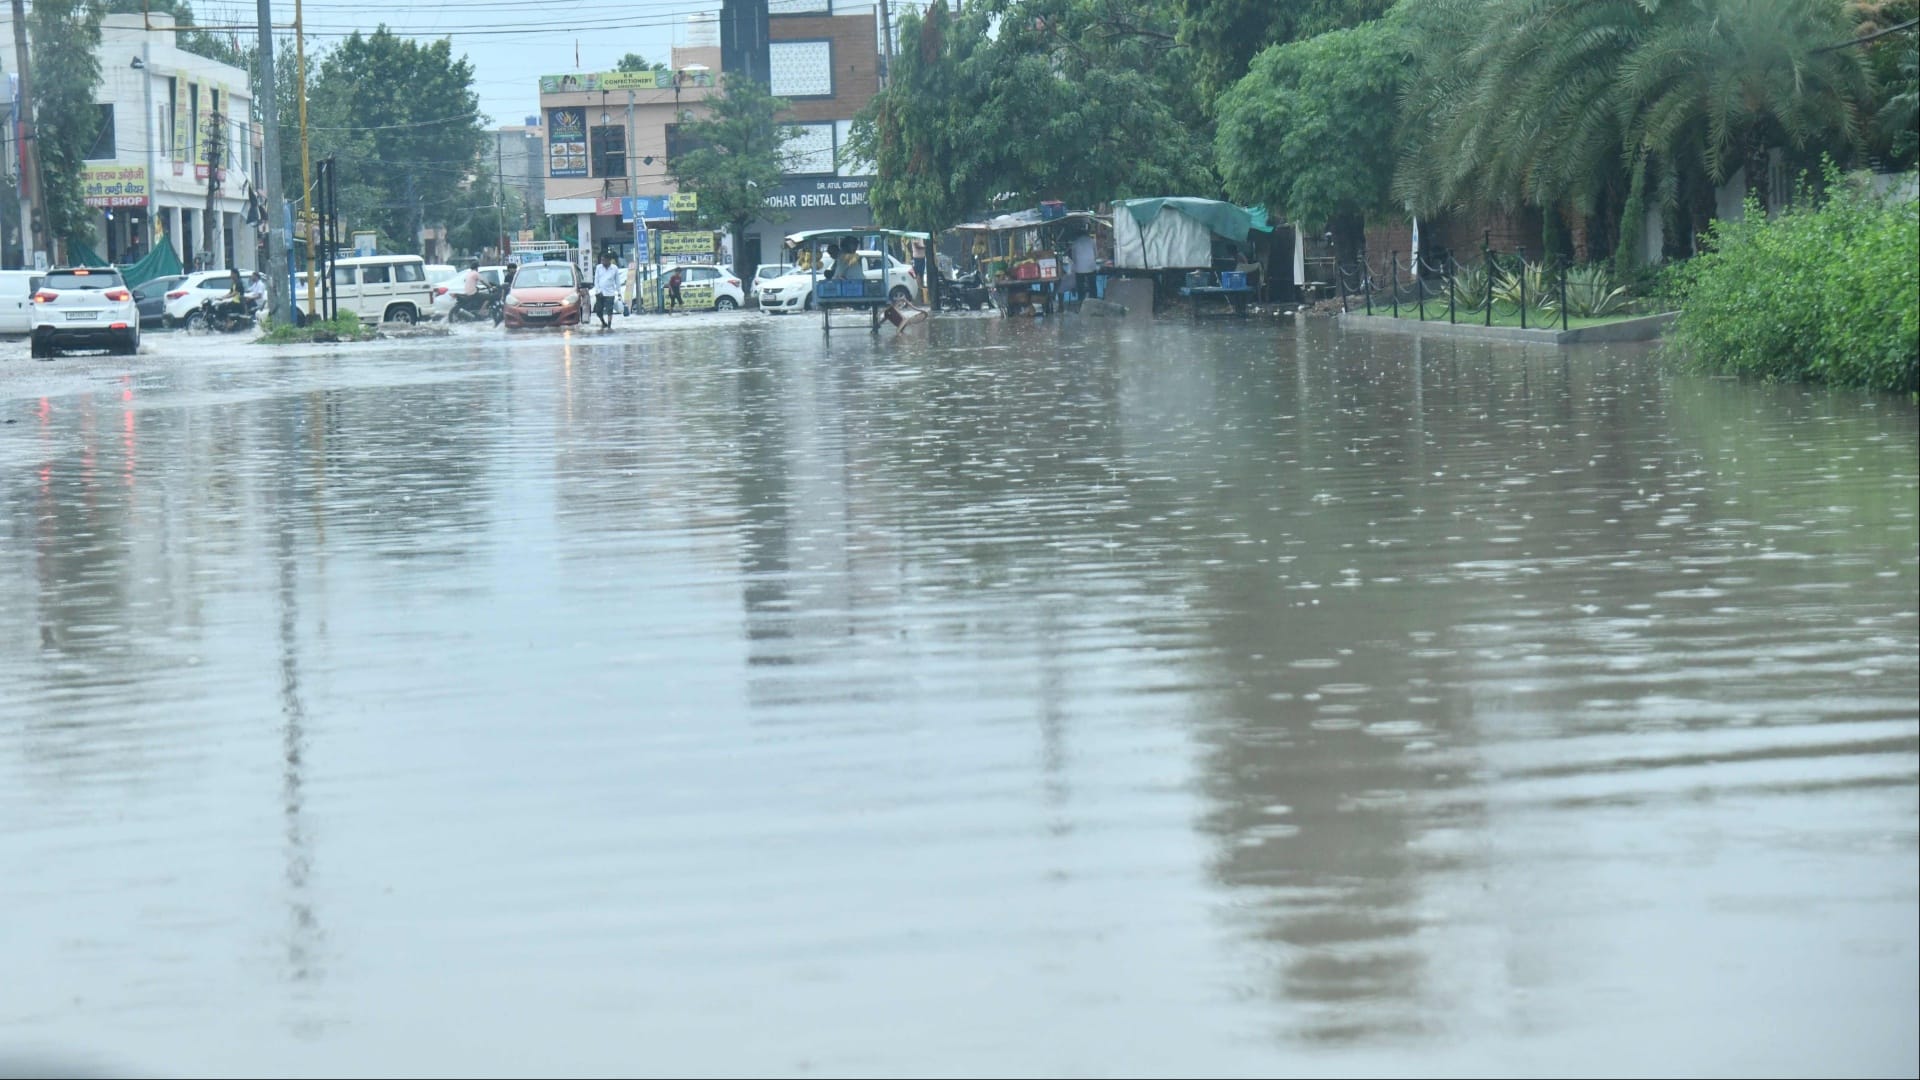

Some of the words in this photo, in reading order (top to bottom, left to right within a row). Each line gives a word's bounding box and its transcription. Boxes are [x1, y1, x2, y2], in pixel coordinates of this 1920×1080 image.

[842, 181, 868, 189] GIRDHAR
[111, 197, 143, 206] SHOP
[801, 193, 837, 207] DENTAL
